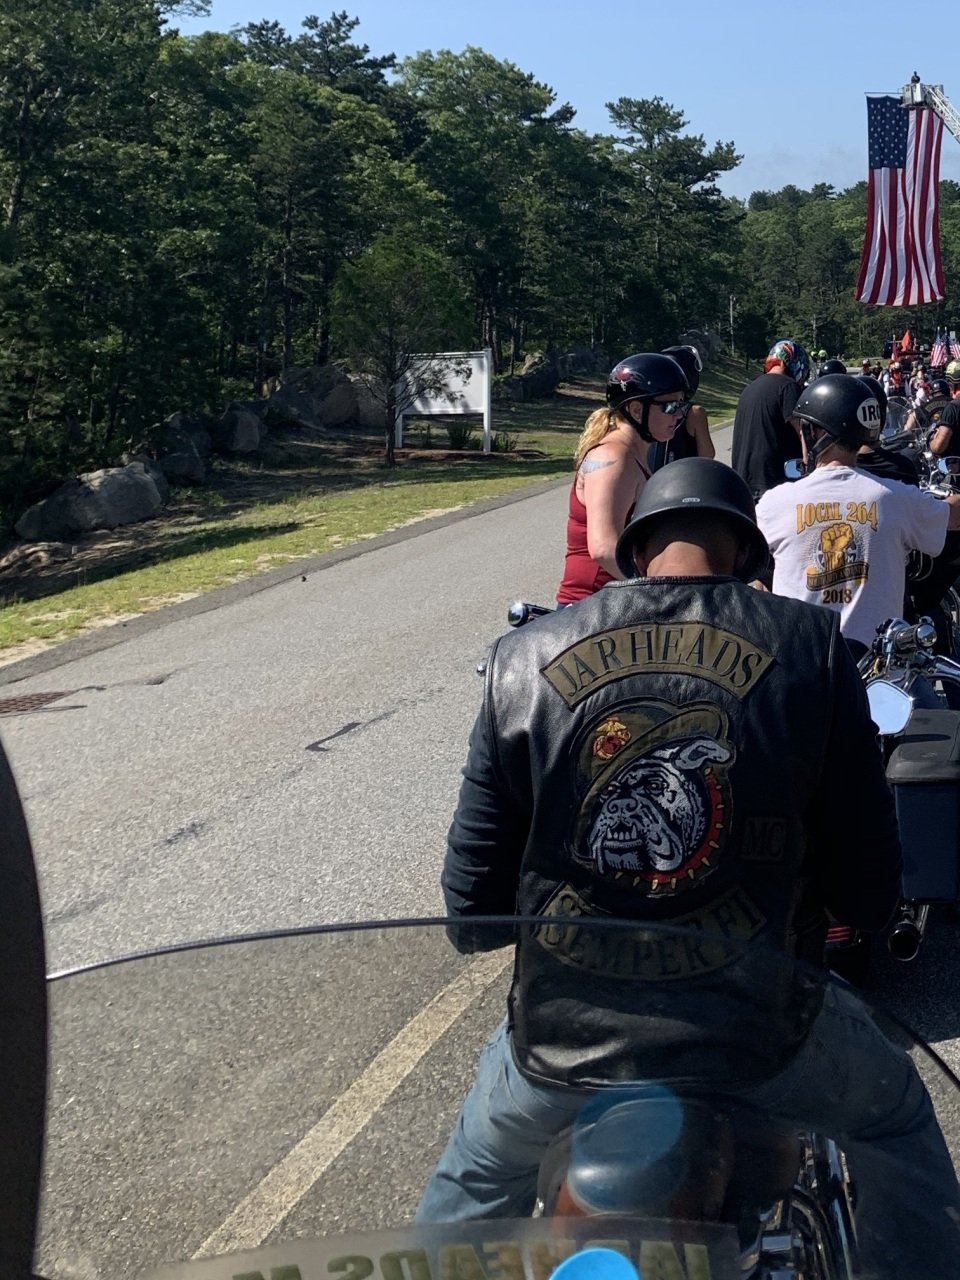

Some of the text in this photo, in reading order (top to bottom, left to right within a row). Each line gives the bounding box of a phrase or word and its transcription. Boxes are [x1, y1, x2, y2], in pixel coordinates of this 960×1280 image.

[796, 501, 878, 534] LOCAL 264
[822, 589, 852, 604] 2018
[553, 628, 763, 697] JARHEADS
